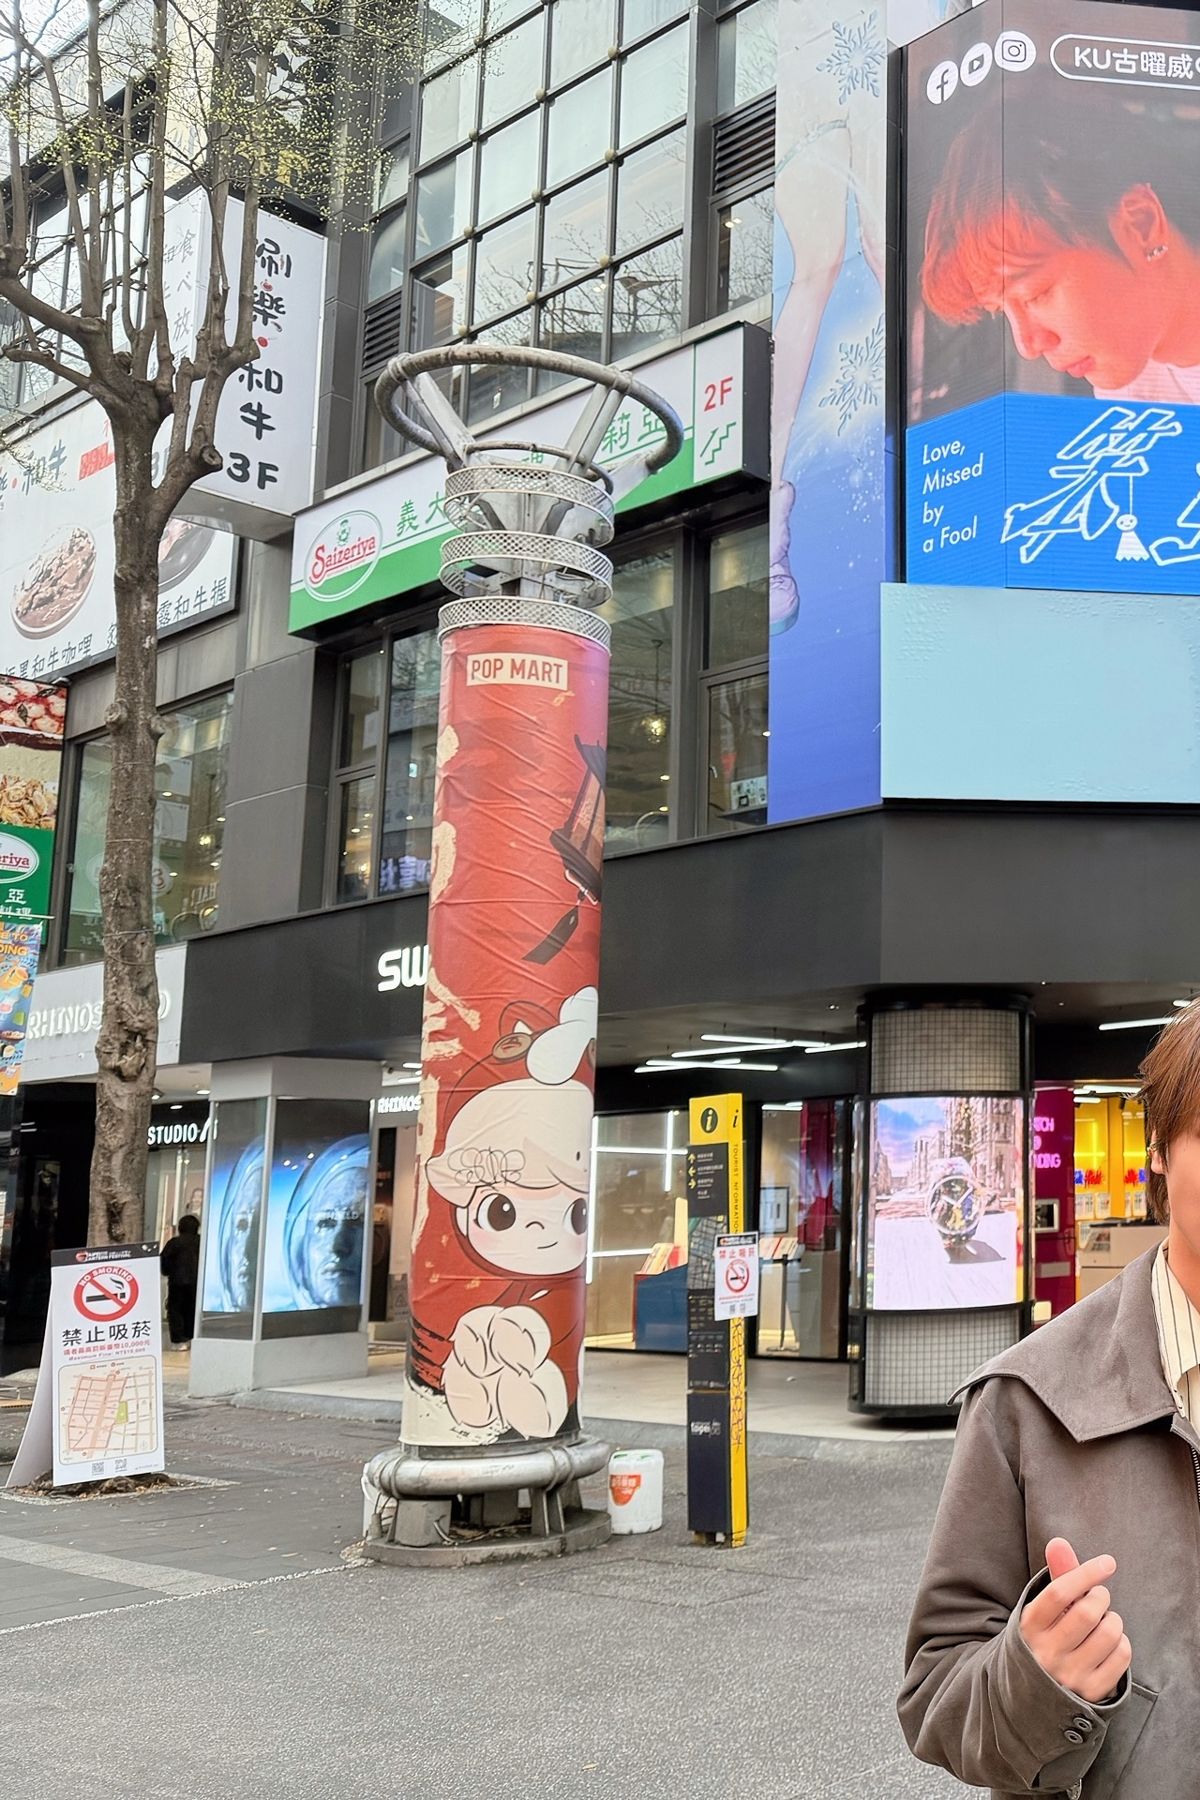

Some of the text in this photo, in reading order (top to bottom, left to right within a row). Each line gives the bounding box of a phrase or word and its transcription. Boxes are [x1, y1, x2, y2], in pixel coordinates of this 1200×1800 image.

[1074, 46, 1194, 80] KU古曜威
[703, 376, 734, 412] 2F
[921, 438, 966, 466] Love,
[226, 451, 279, 490] 3F
[922, 453, 984, 495] Missed
[922, 501, 944, 527] by
[922, 515, 978, 553] a Fool
[309, 536, 376, 584] Saizeriya
[470, 658, 564, 686] POP MART
[147, 1122, 197, 1145] STUDIO
[79, 1266, 133, 1286] NO SMOKING
[62, 1320, 151, 1347] 禁止吸菸
